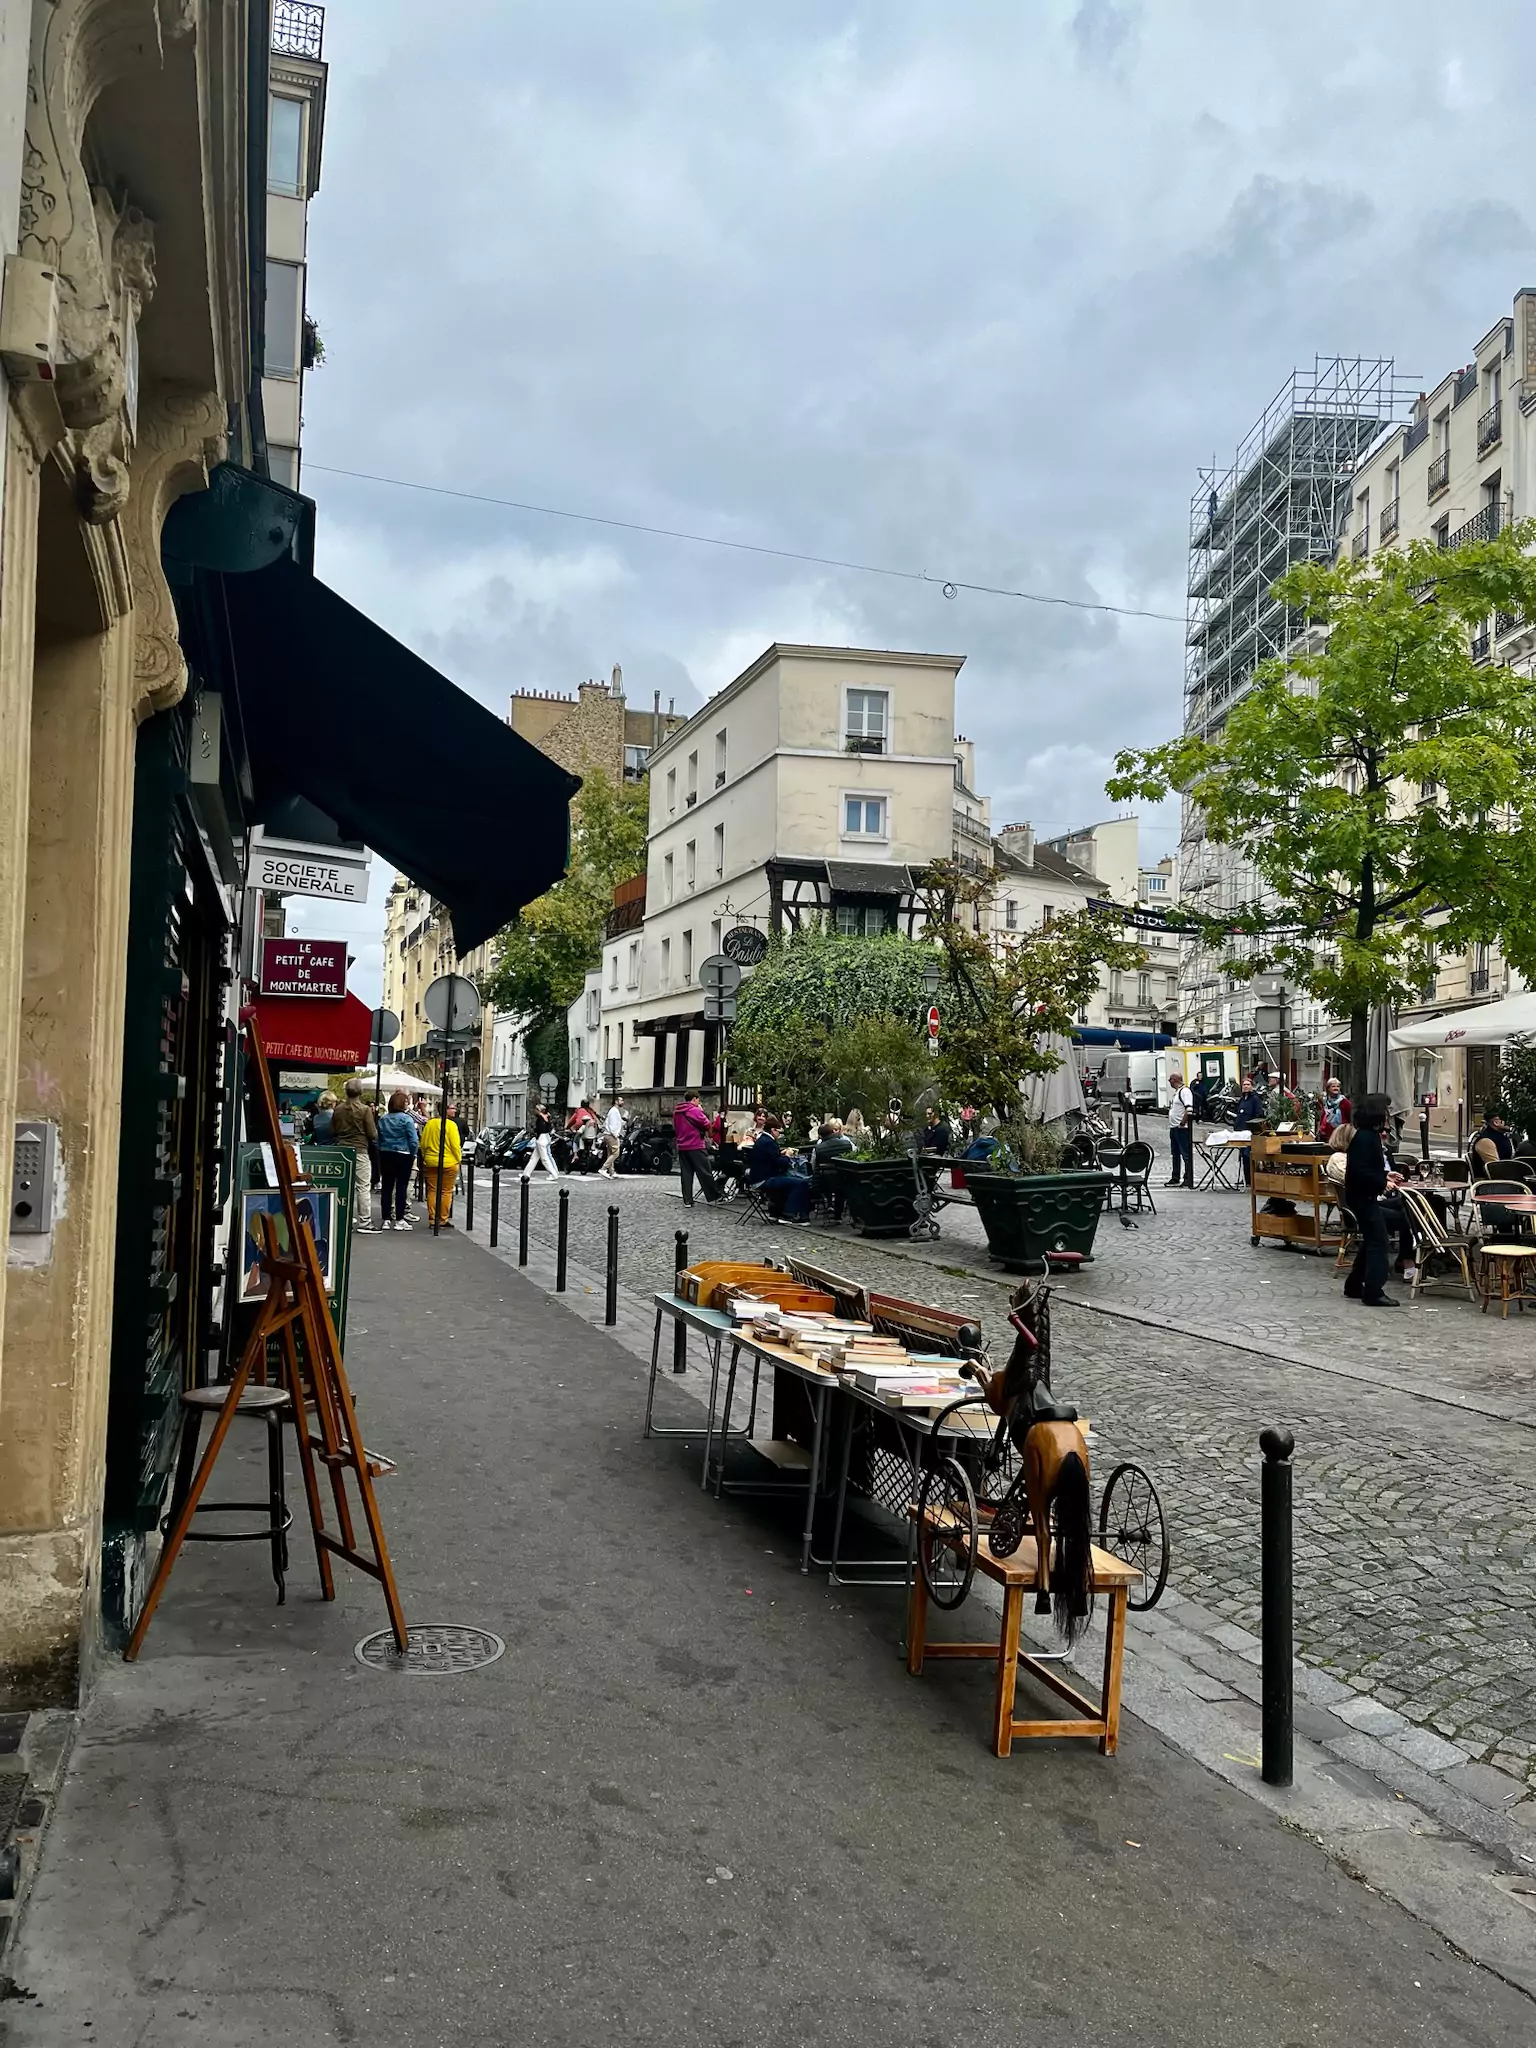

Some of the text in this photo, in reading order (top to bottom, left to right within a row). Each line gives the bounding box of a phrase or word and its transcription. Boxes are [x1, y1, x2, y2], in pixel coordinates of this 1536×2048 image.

[264, 860, 339, 881] SOCIETE
[262, 873, 355, 896] GENERALE
[299, 944, 312, 954] LE
[275, 955, 335, 968] PETIT CAFE
[297, 969, 311, 979] DE
[269, 981, 338, 993] MONTMARTRE
[265, 1041, 285, 1055] PETIT
[303, 1045, 313, 1058] DE
[313, 1046, 360, 1063] MONTMARTRE
